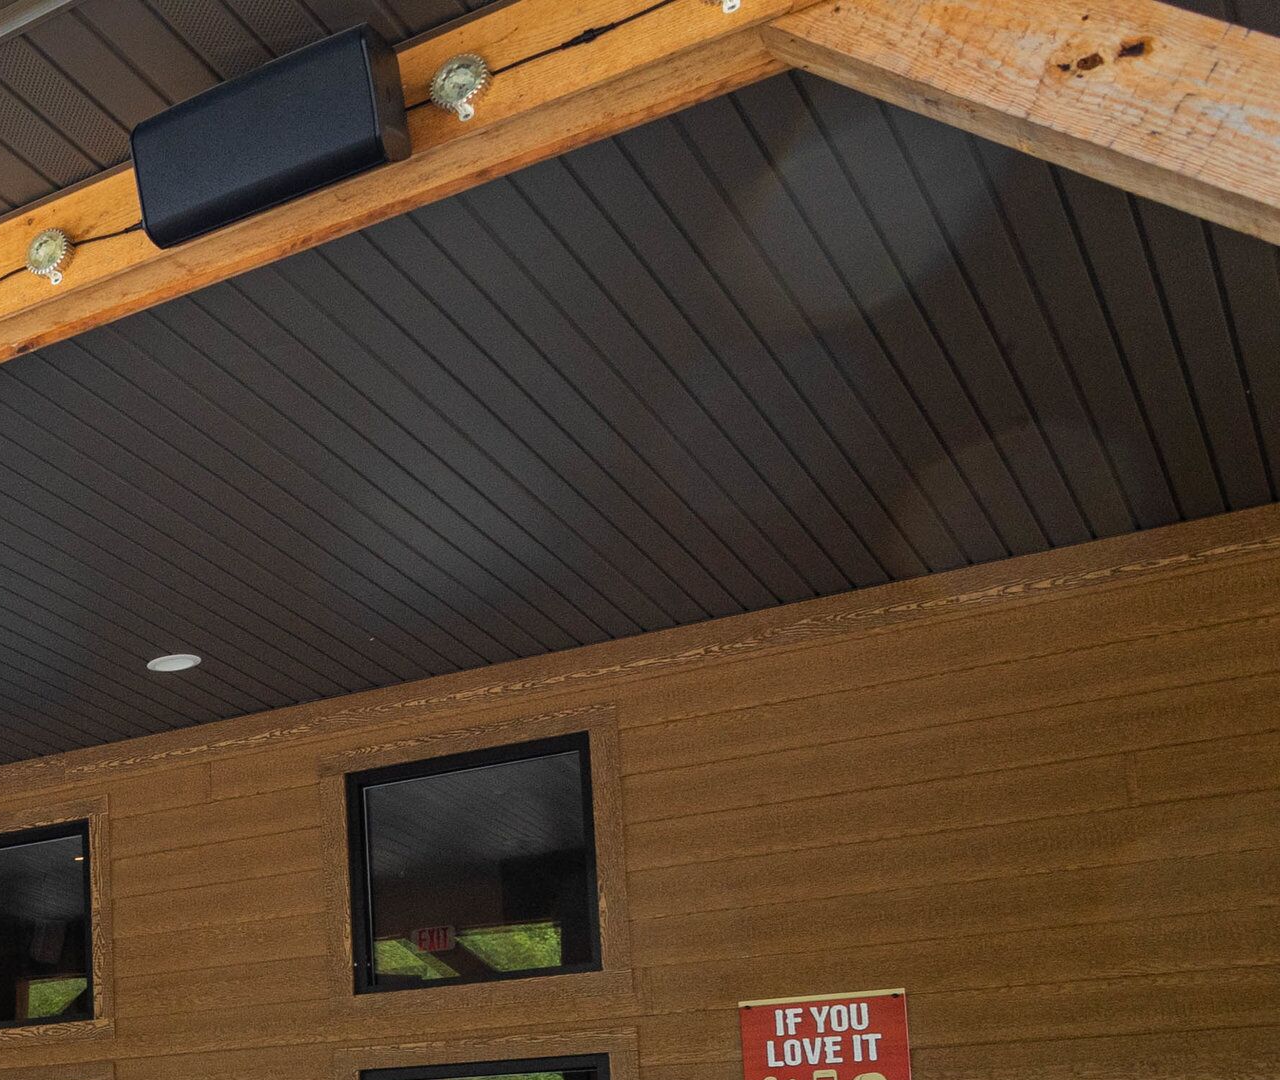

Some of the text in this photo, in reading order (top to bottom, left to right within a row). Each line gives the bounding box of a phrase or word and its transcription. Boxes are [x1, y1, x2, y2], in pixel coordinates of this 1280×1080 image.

[774, 1003, 869, 1036] IF YOU
[766, 1033, 882, 1067] LOVE IT
